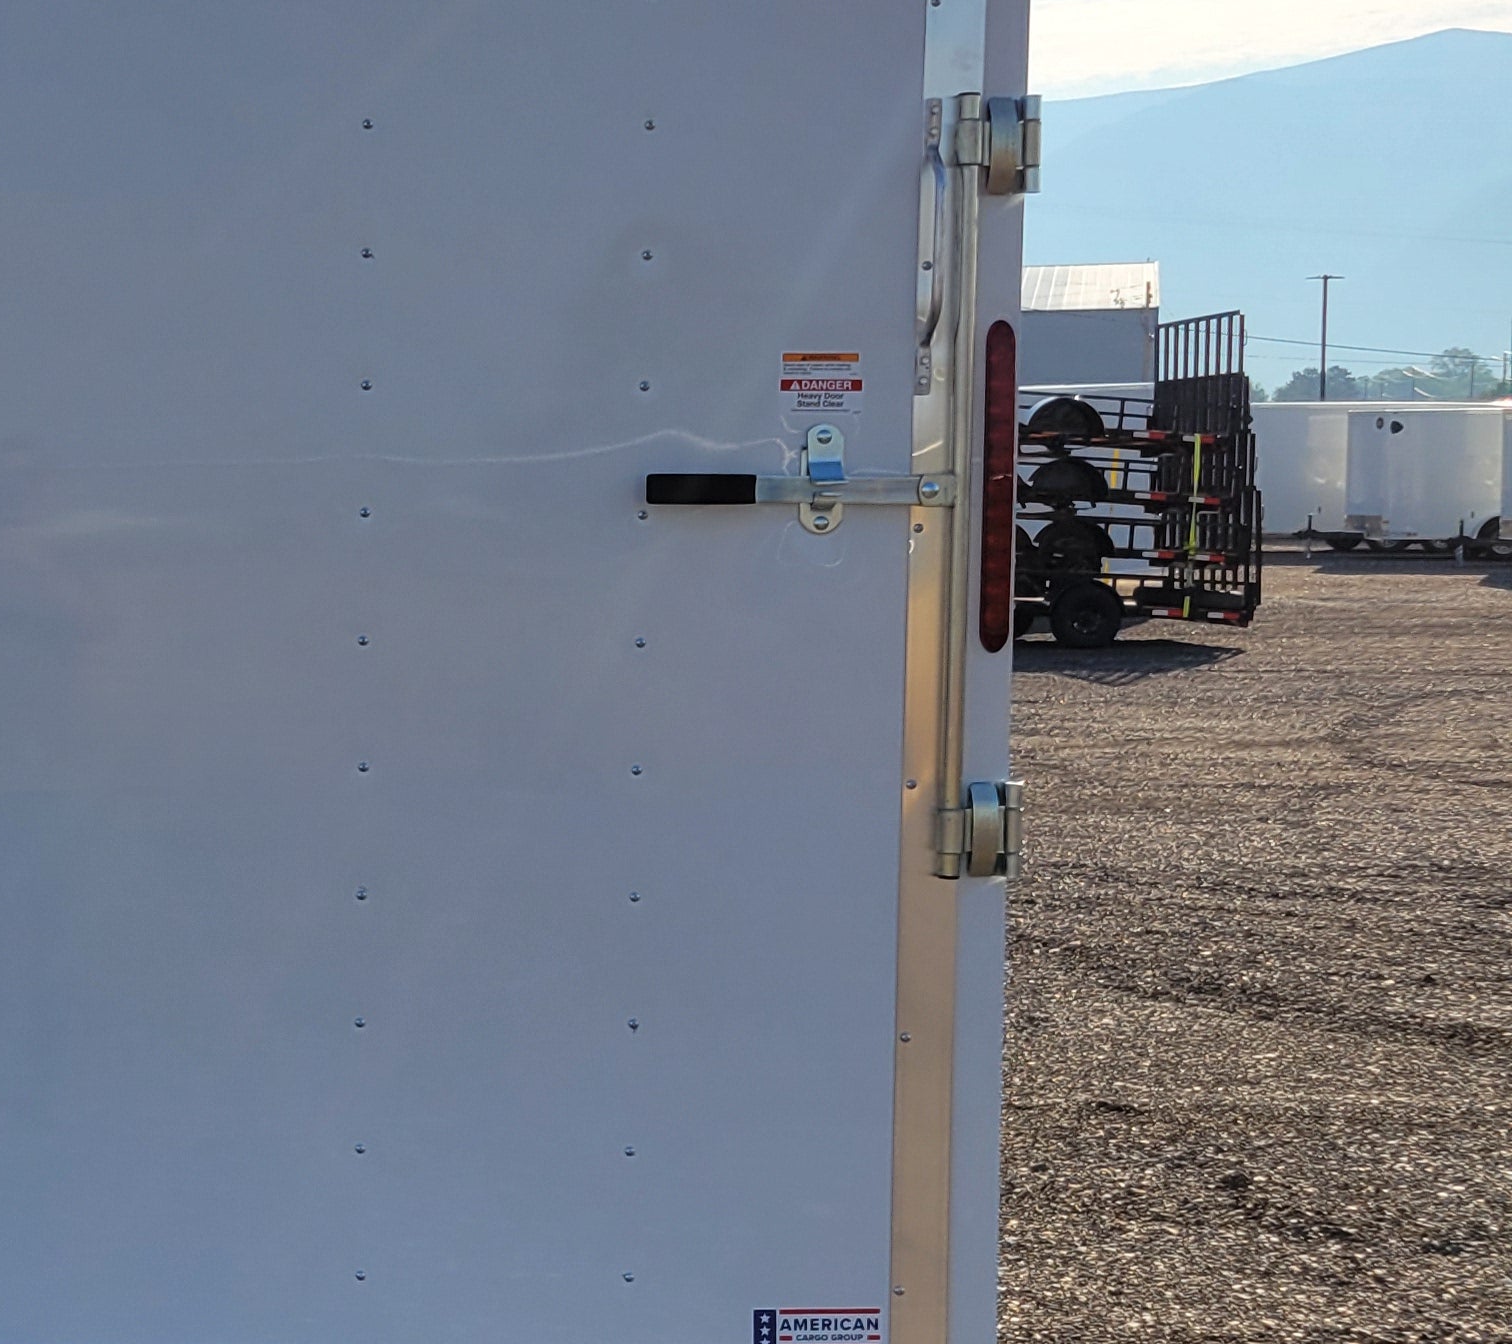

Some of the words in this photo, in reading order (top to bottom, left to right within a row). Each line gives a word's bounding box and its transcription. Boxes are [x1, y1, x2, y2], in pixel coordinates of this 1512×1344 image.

[801, 380, 852, 390] DANGER
[797, 393, 822, 401] Heavy
[779, 1317, 879, 1331] AMERICAN
[795, 1334, 828, 1342] CARGO
[830, 1334, 864, 1342] GROUP
